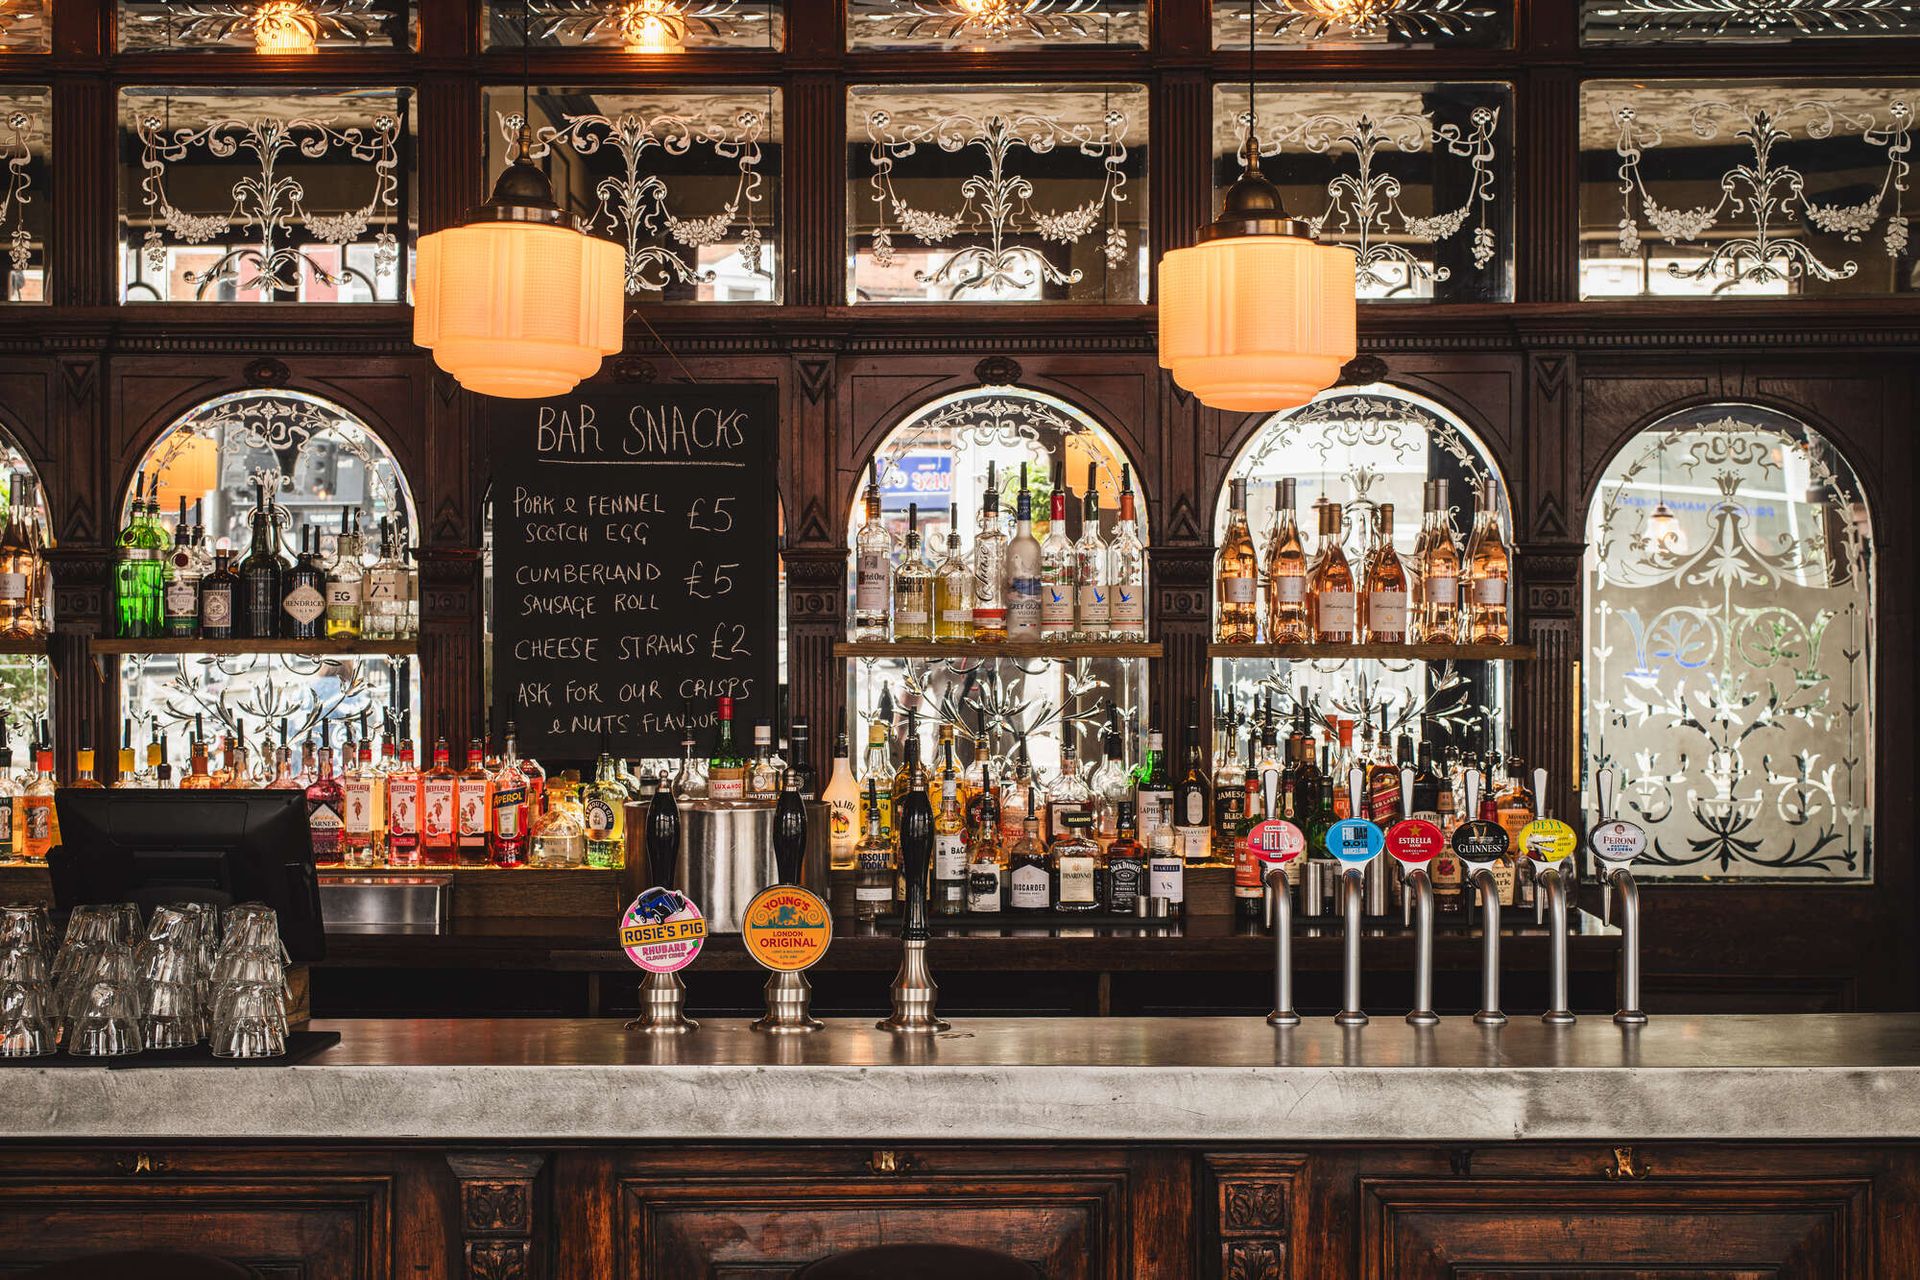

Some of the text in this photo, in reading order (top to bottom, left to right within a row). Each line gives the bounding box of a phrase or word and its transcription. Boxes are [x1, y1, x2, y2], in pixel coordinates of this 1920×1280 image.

[537, 403, 749, 456] BAR SNACKS
[513, 486, 554, 517] PORK
[588, 493, 666, 516] FENNEL
[687, 497, 736, 532] £5
[525, 522, 650, 545] SCOTCH EGG
[515, 562, 661, 586] CUMBERLAND
[683, 560, 740, 599] £5
[334, 591, 351, 602] EG
[521, 593, 660, 619] SAUSAGE ROLL
[515, 622, 752, 662] CHEESE STRAWS £2
[518, 677, 754, 708] ASK FOR OUR CRISPS
[572, 714, 630, 734] NUTS
[494, 791, 523, 806] APEROL
[1217, 790, 1245, 800] JAMESO
[832, 799, 857, 814] ALIBU
[1222, 822, 1237, 830] BAR
[1458, 843, 1504, 853] GUINNESS
[1603, 836, 1636, 845] PERONI
[858, 853, 890, 861] ABSOLUT
[861, 861, 888, 869] VODKA
[1110, 863, 1123, 873] JACK
[1013, 883, 1046, 891] DISCARDED
[1161, 882, 1173, 890] VS
[763, 896, 811, 912] YOUNG'S
[624, 922, 703, 943] ROSIE'S PIG
[642, 943, 687, 956] RHUBARB
[760, 938, 817, 948] ORIGINAL
